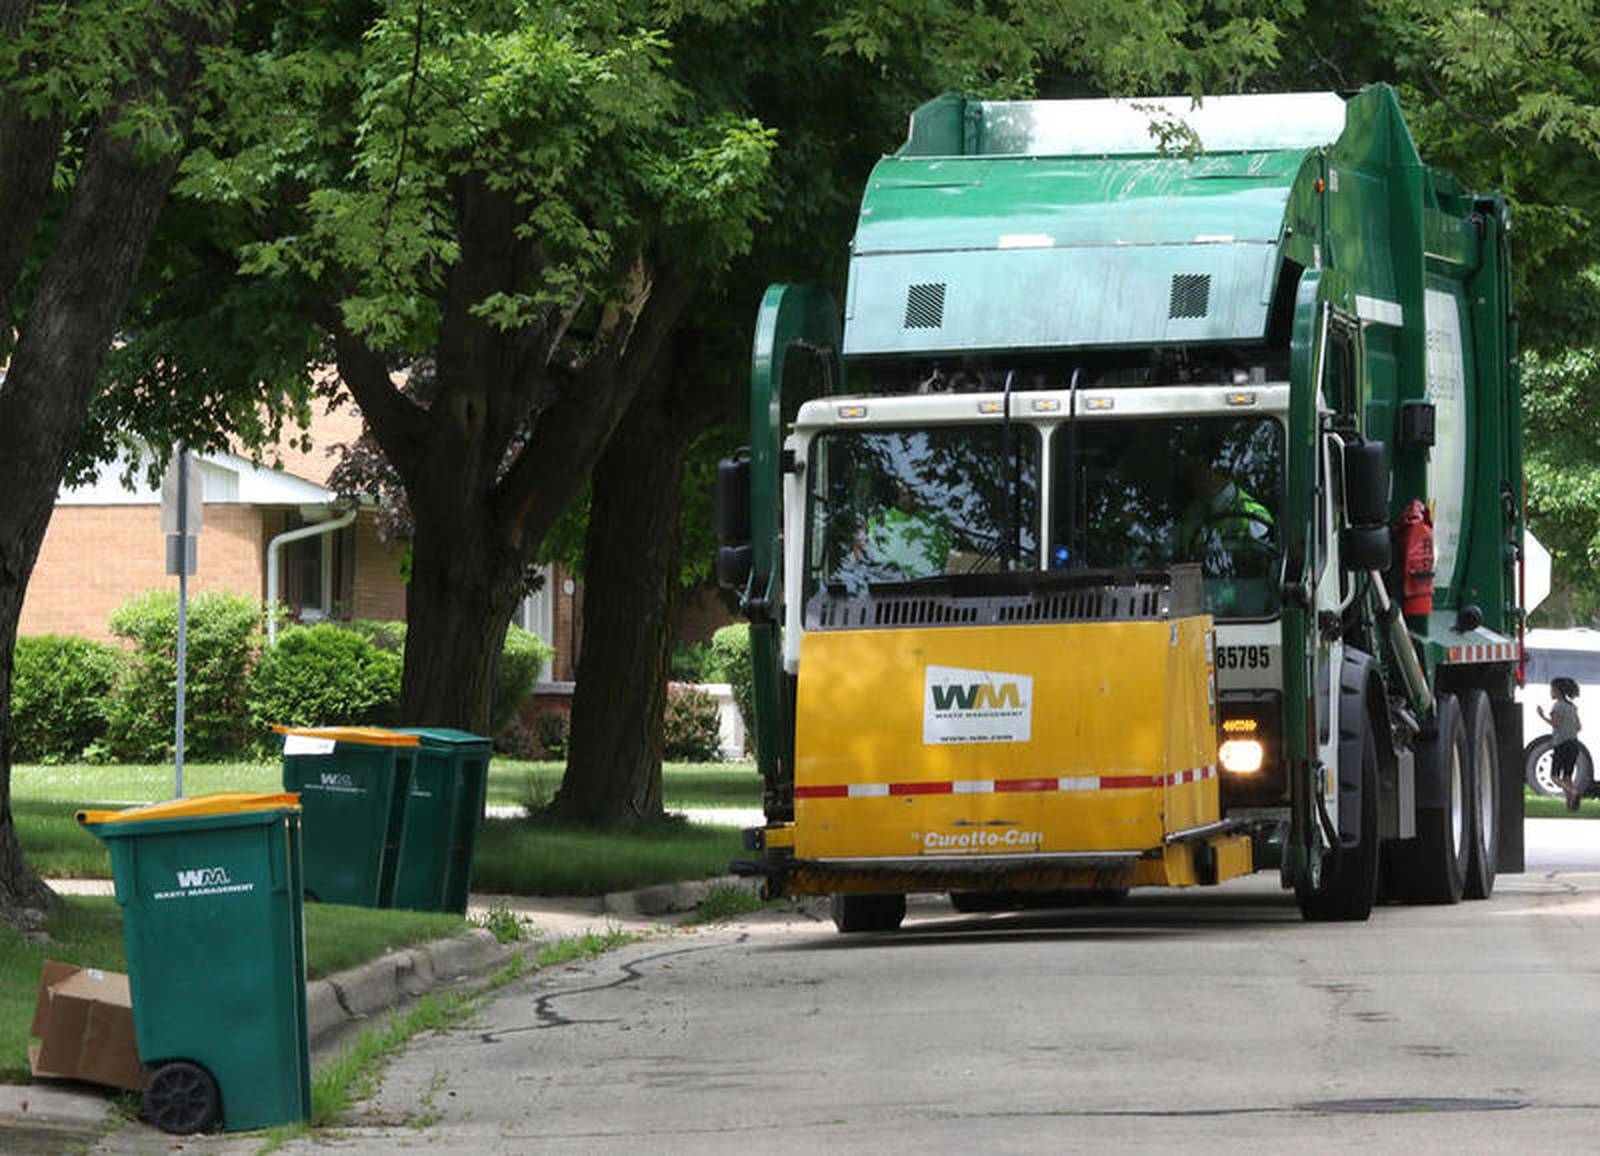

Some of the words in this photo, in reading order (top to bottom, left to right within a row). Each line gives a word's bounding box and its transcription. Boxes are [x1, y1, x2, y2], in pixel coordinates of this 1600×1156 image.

[1216, 645, 1270, 669] 65795
[931, 683, 1020, 710] WM
[924, 829, 1044, 848] Curotto-Can
[176, 867, 231, 888] WM
[153, 891, 186, 900] WASTE
[187, 883, 254, 897] MANAGEMENT
